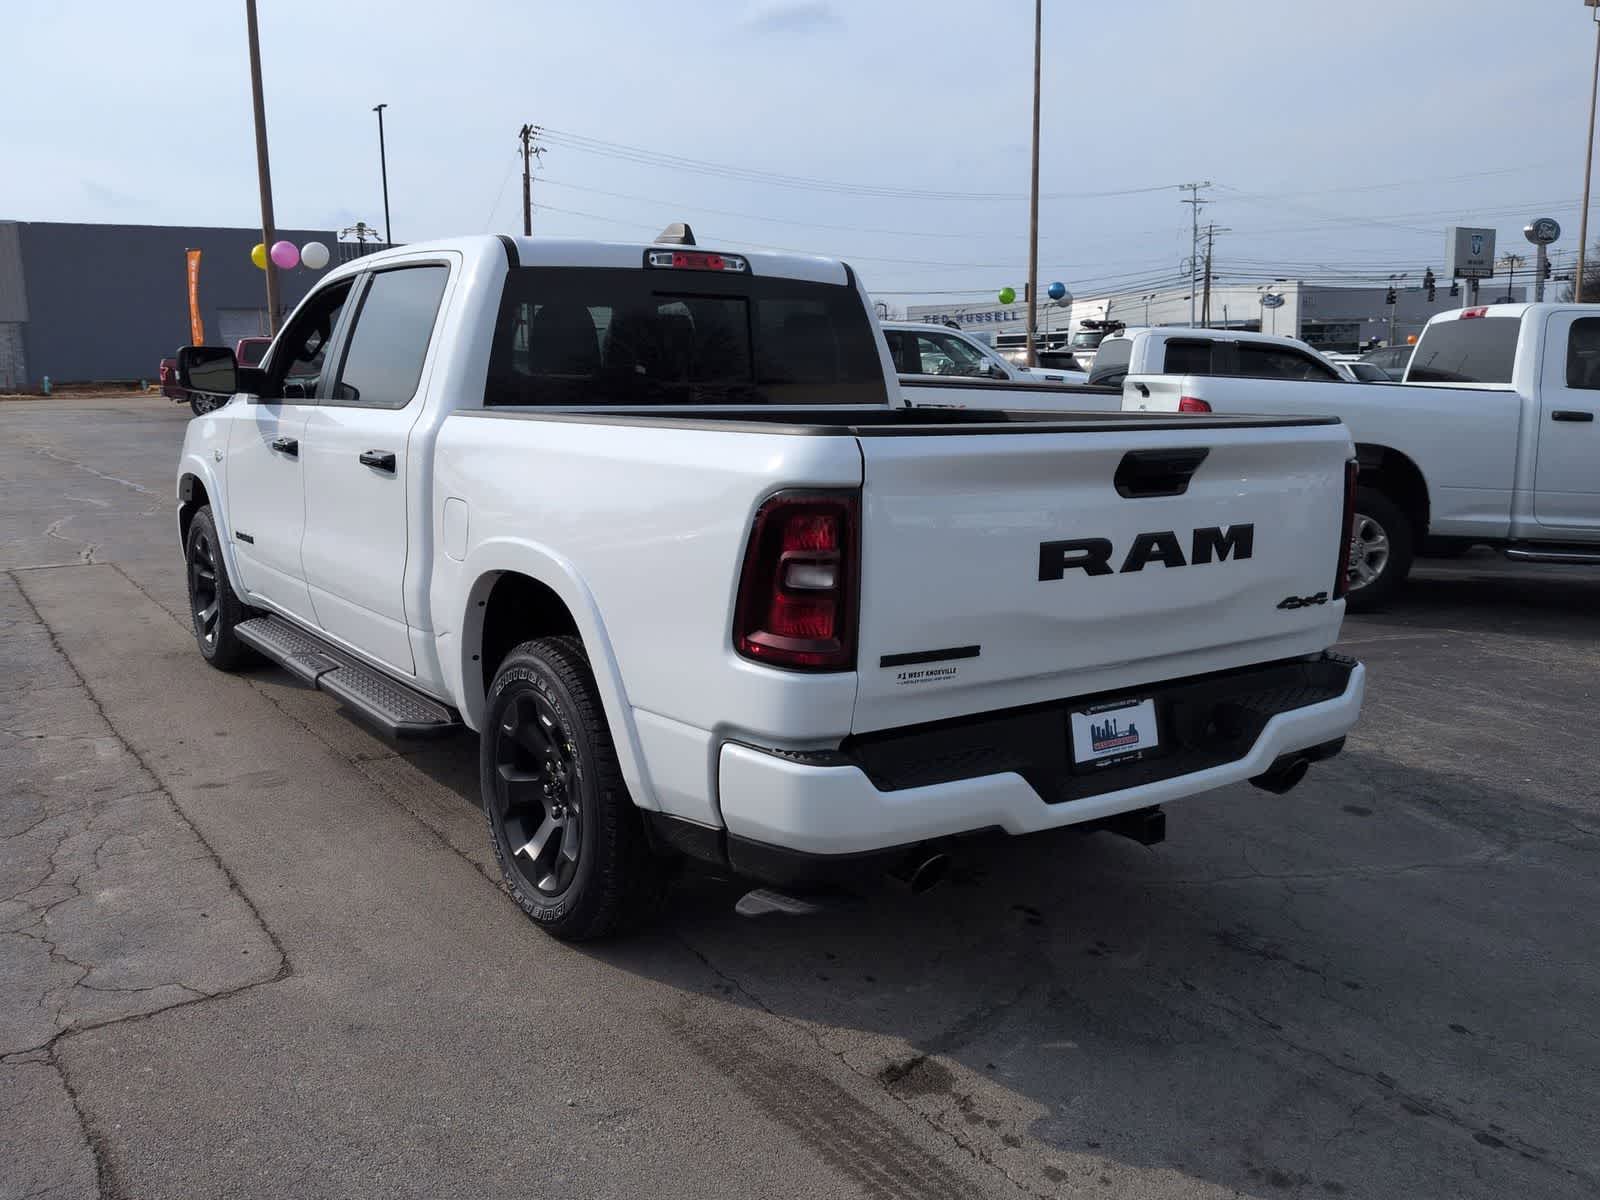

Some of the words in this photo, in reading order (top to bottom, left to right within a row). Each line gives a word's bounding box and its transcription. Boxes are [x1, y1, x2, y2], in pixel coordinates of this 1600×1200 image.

[923, 315, 949, 324] TED
[956, 311, 1018, 323] RUSSELL
[1038, 523, 1254, 582] RAM
[897, 672, 906, 680] #1
[908, 670, 924, 679] WEST
[925, 667, 957, 677] KNOXVILLE
